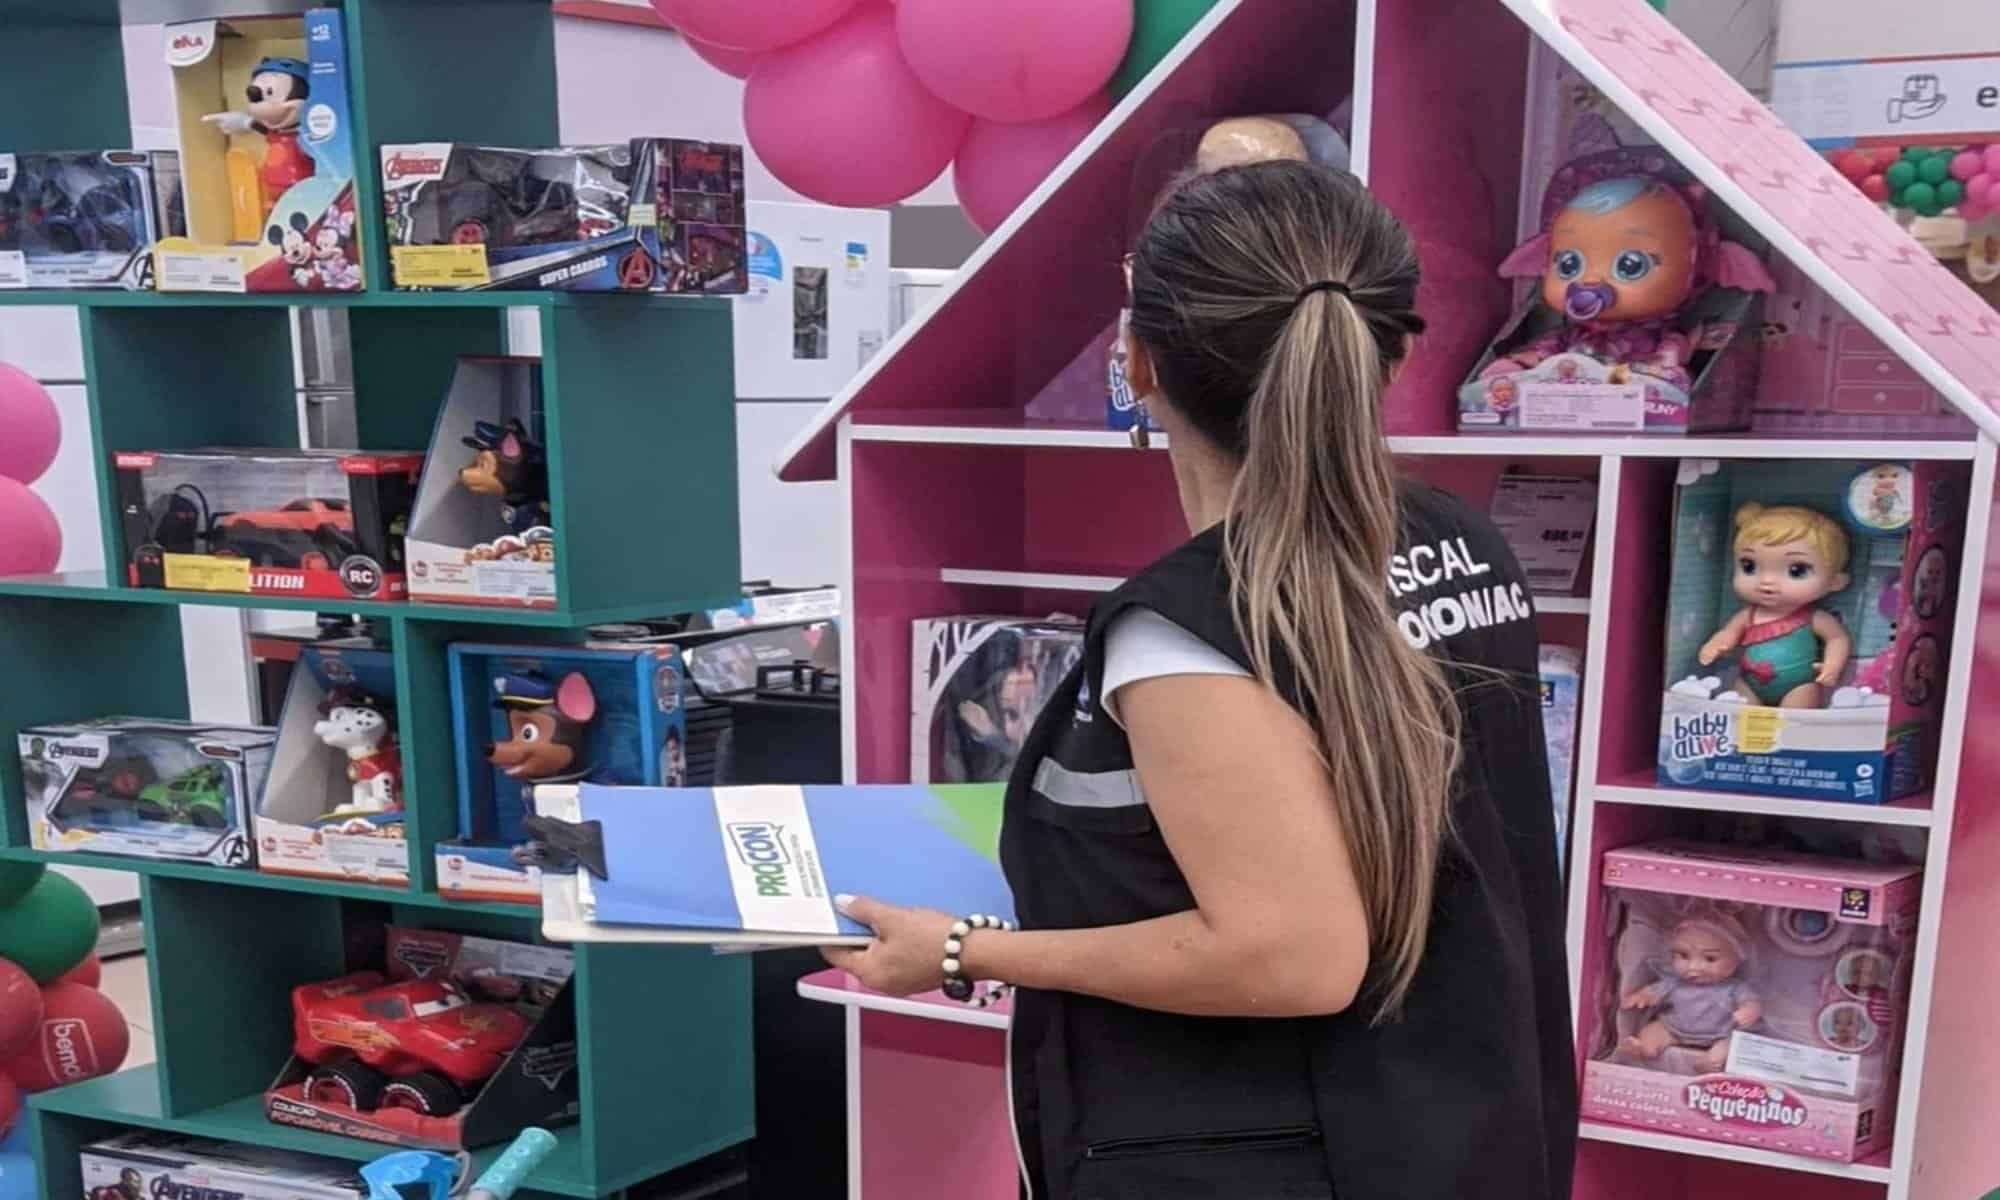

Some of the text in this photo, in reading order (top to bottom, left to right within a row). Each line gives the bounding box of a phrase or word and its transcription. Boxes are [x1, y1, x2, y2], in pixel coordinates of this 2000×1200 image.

[349, 569, 373, 584] RC
[1674, 711, 1728, 740] baby
[1674, 735, 1729, 759] alive
[735, 826, 792, 897] PROCON
[1687, 1084, 1805, 1125] Pequeninos
